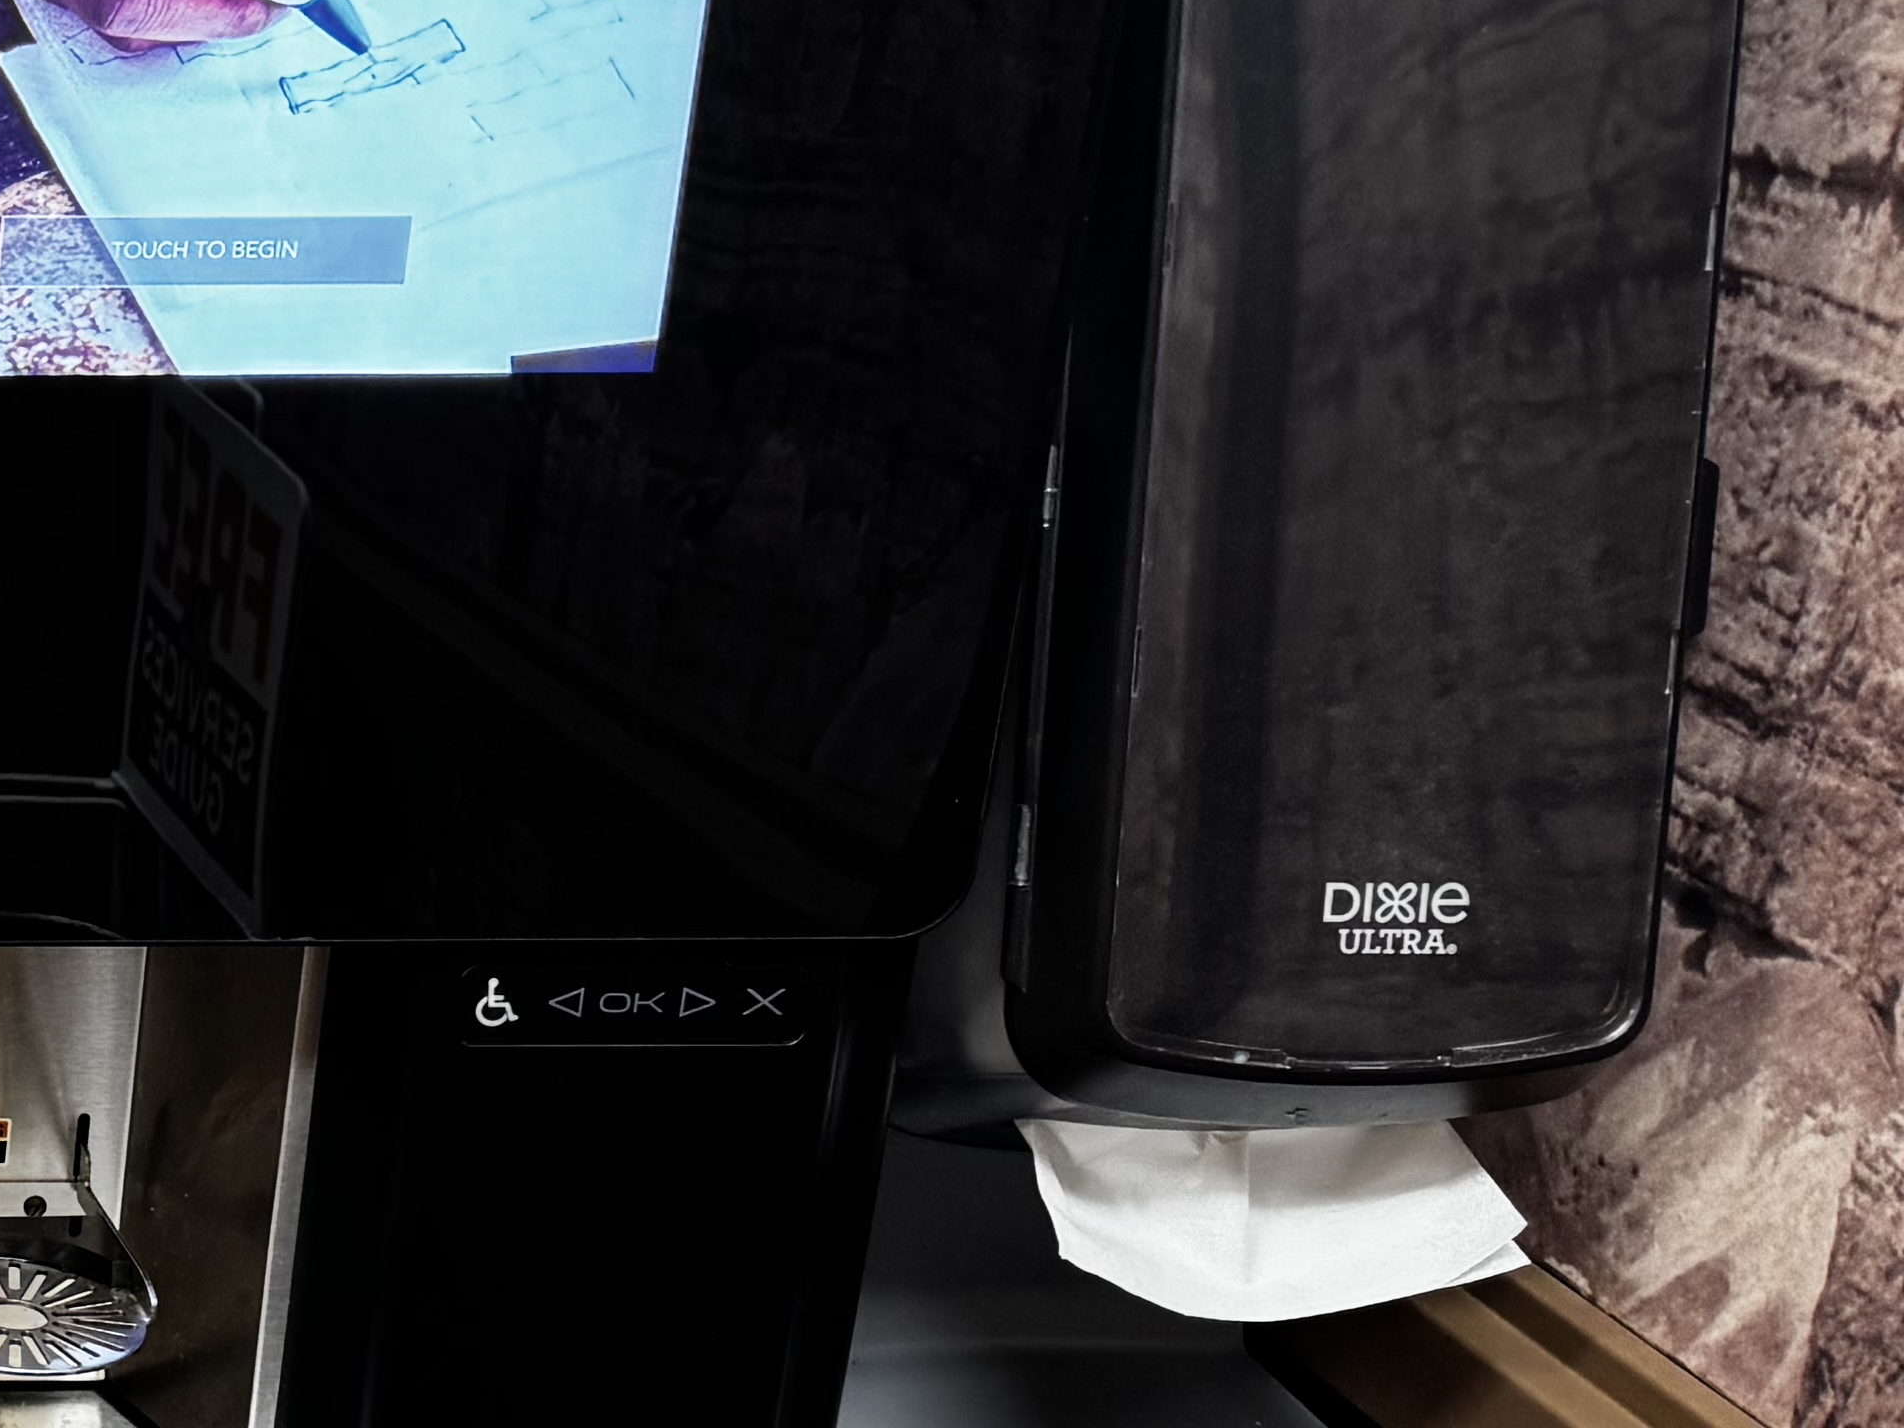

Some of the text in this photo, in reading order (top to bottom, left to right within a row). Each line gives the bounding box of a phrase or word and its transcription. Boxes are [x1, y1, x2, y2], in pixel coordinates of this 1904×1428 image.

[112, 240, 299, 260] TOUCH TO BEGIN
[599, 992, 666, 1013] OK
